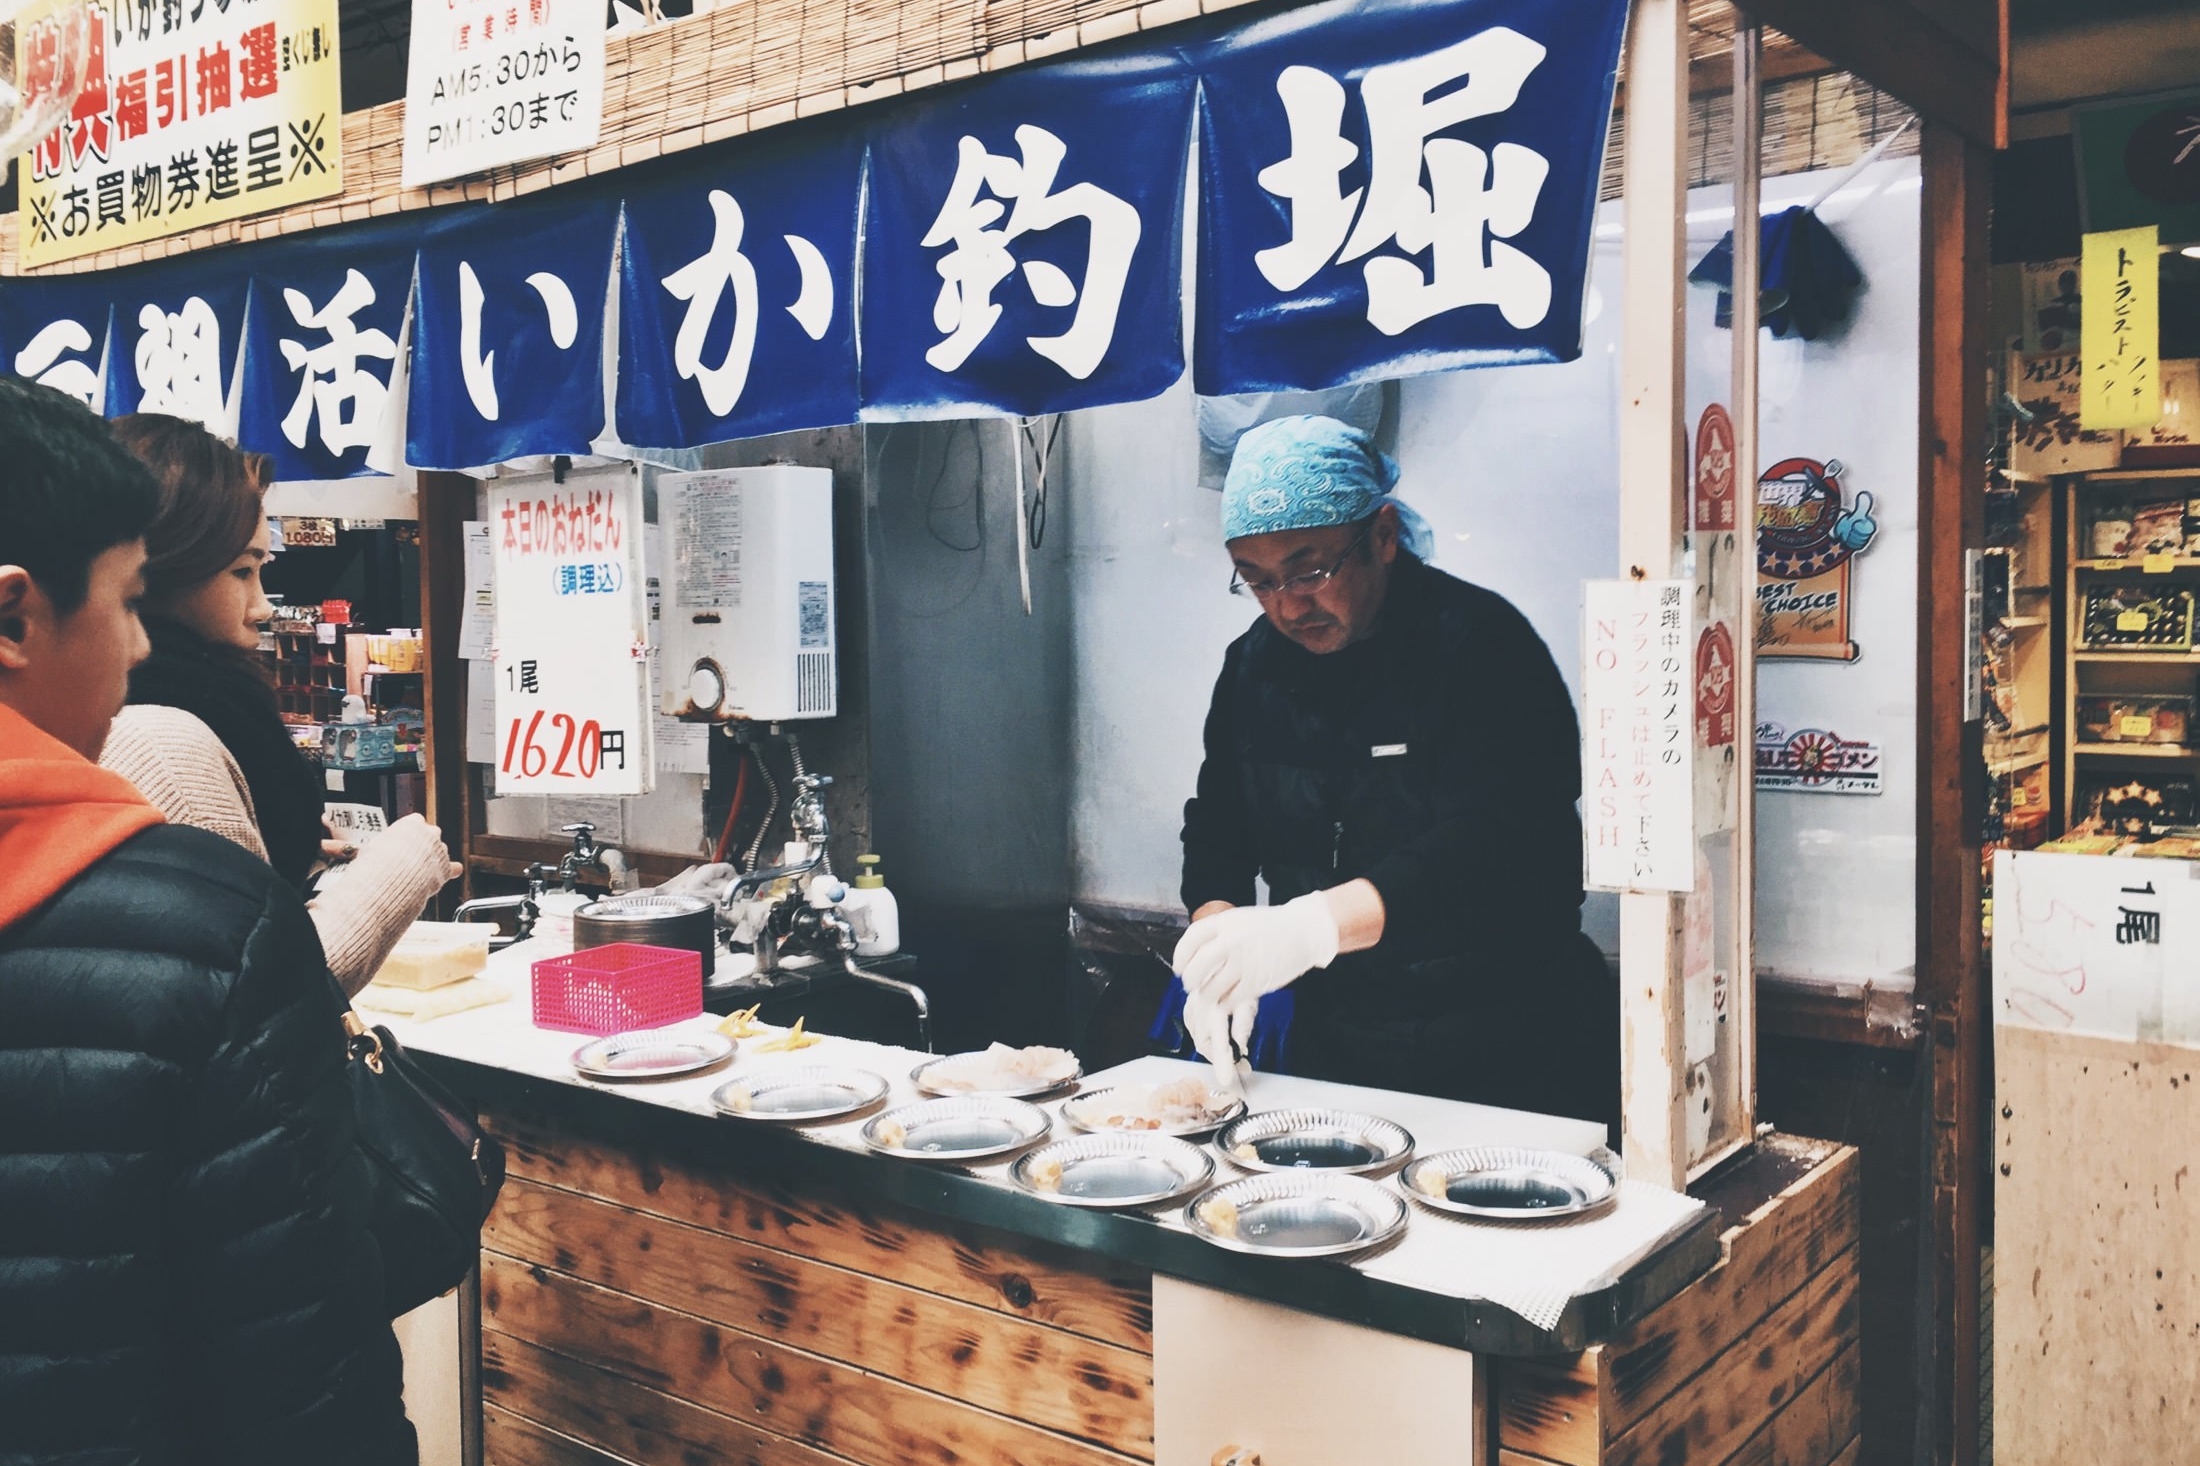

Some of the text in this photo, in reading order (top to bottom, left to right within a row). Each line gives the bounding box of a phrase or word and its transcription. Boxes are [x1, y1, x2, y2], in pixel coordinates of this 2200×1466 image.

[116, 21, 279, 142] 福引抽選
[431, 36, 582, 106] AM5:30から
[426, 89, 579, 154] PM1:30まで
[501, 489, 621, 561] 本日のおねだん
[552, 562, 624, 595] (調理込)
[1764, 592, 1838, 615] CHOICE
[506, 659, 540, 694] 1尾
[1660, 586, 1682, 766] 調理中のカメラの
[1596, 619, 1619, 848] NO FLASH
[1631, 611, 1653, 877] フラッシュは止めて下さい
[2115, 881, 2161, 945] 1尾
